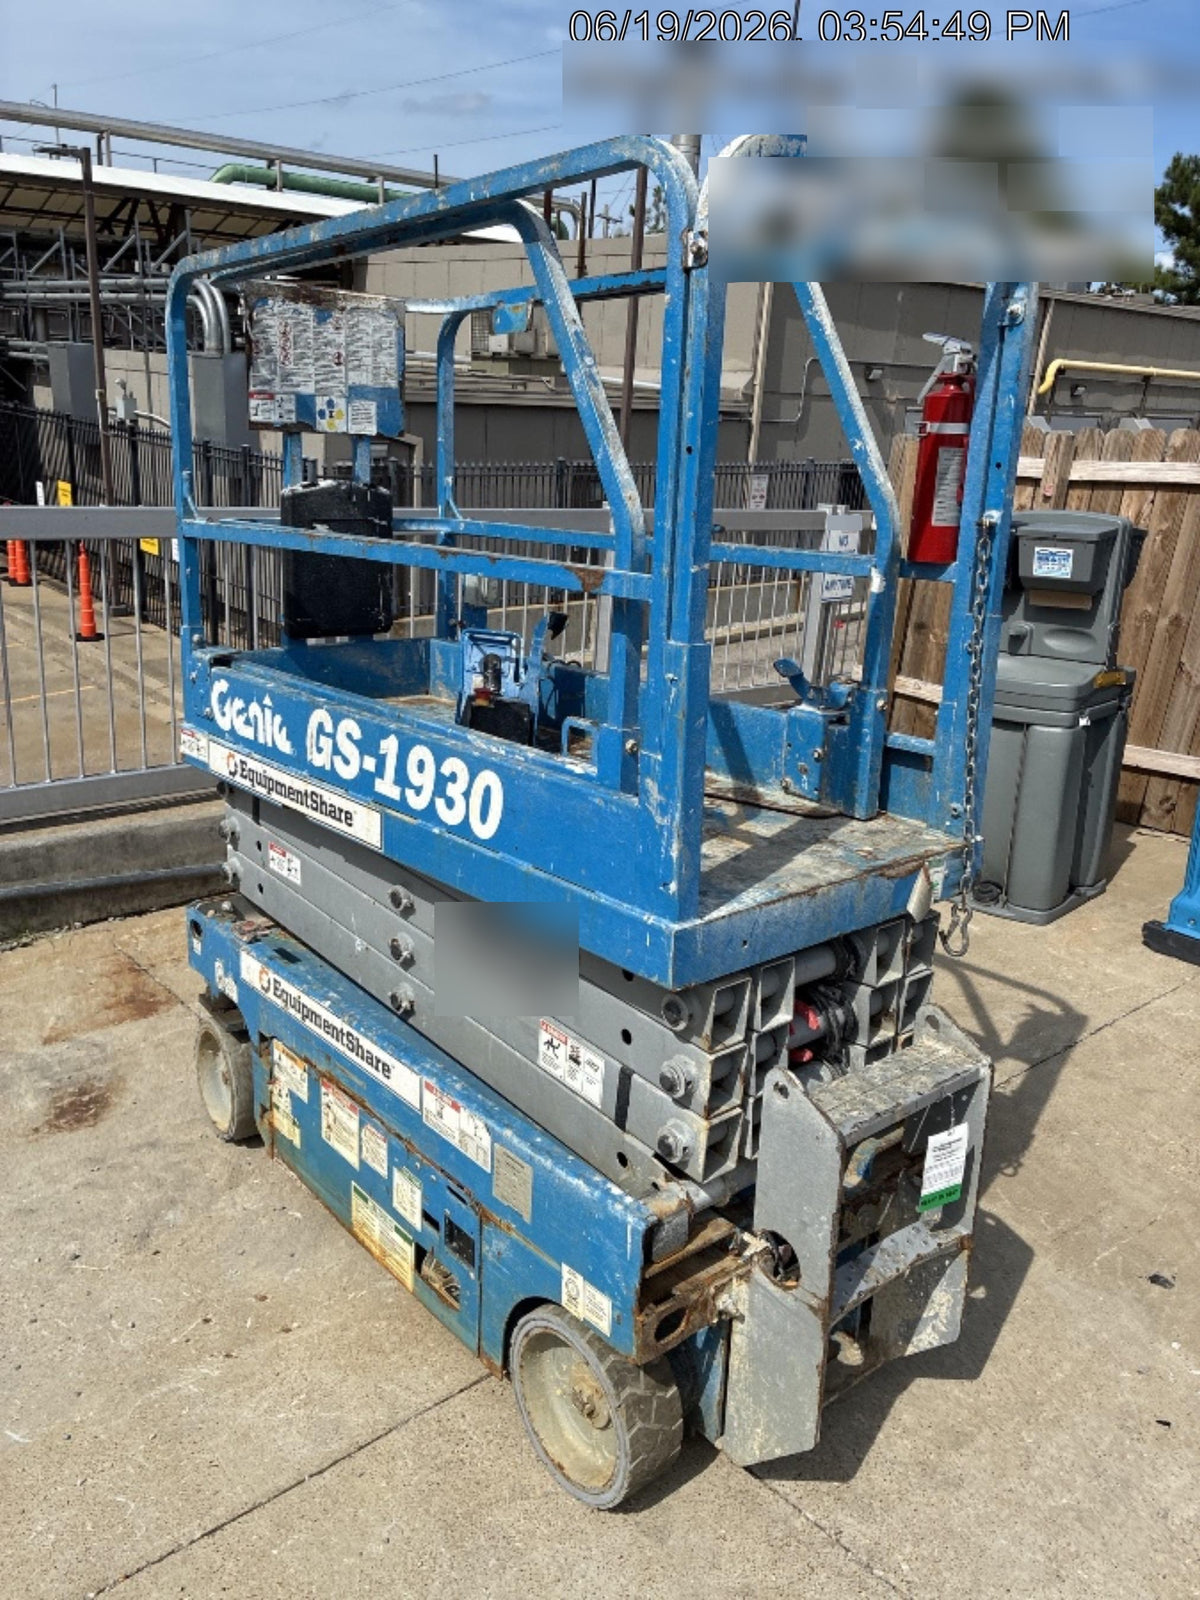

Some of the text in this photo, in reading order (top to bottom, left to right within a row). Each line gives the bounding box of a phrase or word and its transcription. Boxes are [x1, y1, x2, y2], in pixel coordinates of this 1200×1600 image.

[239, 758, 354, 827] EquipmentShare
[306, 708, 504, 840] GS-1930
[273, 977, 393, 1080] EquipmentShare
